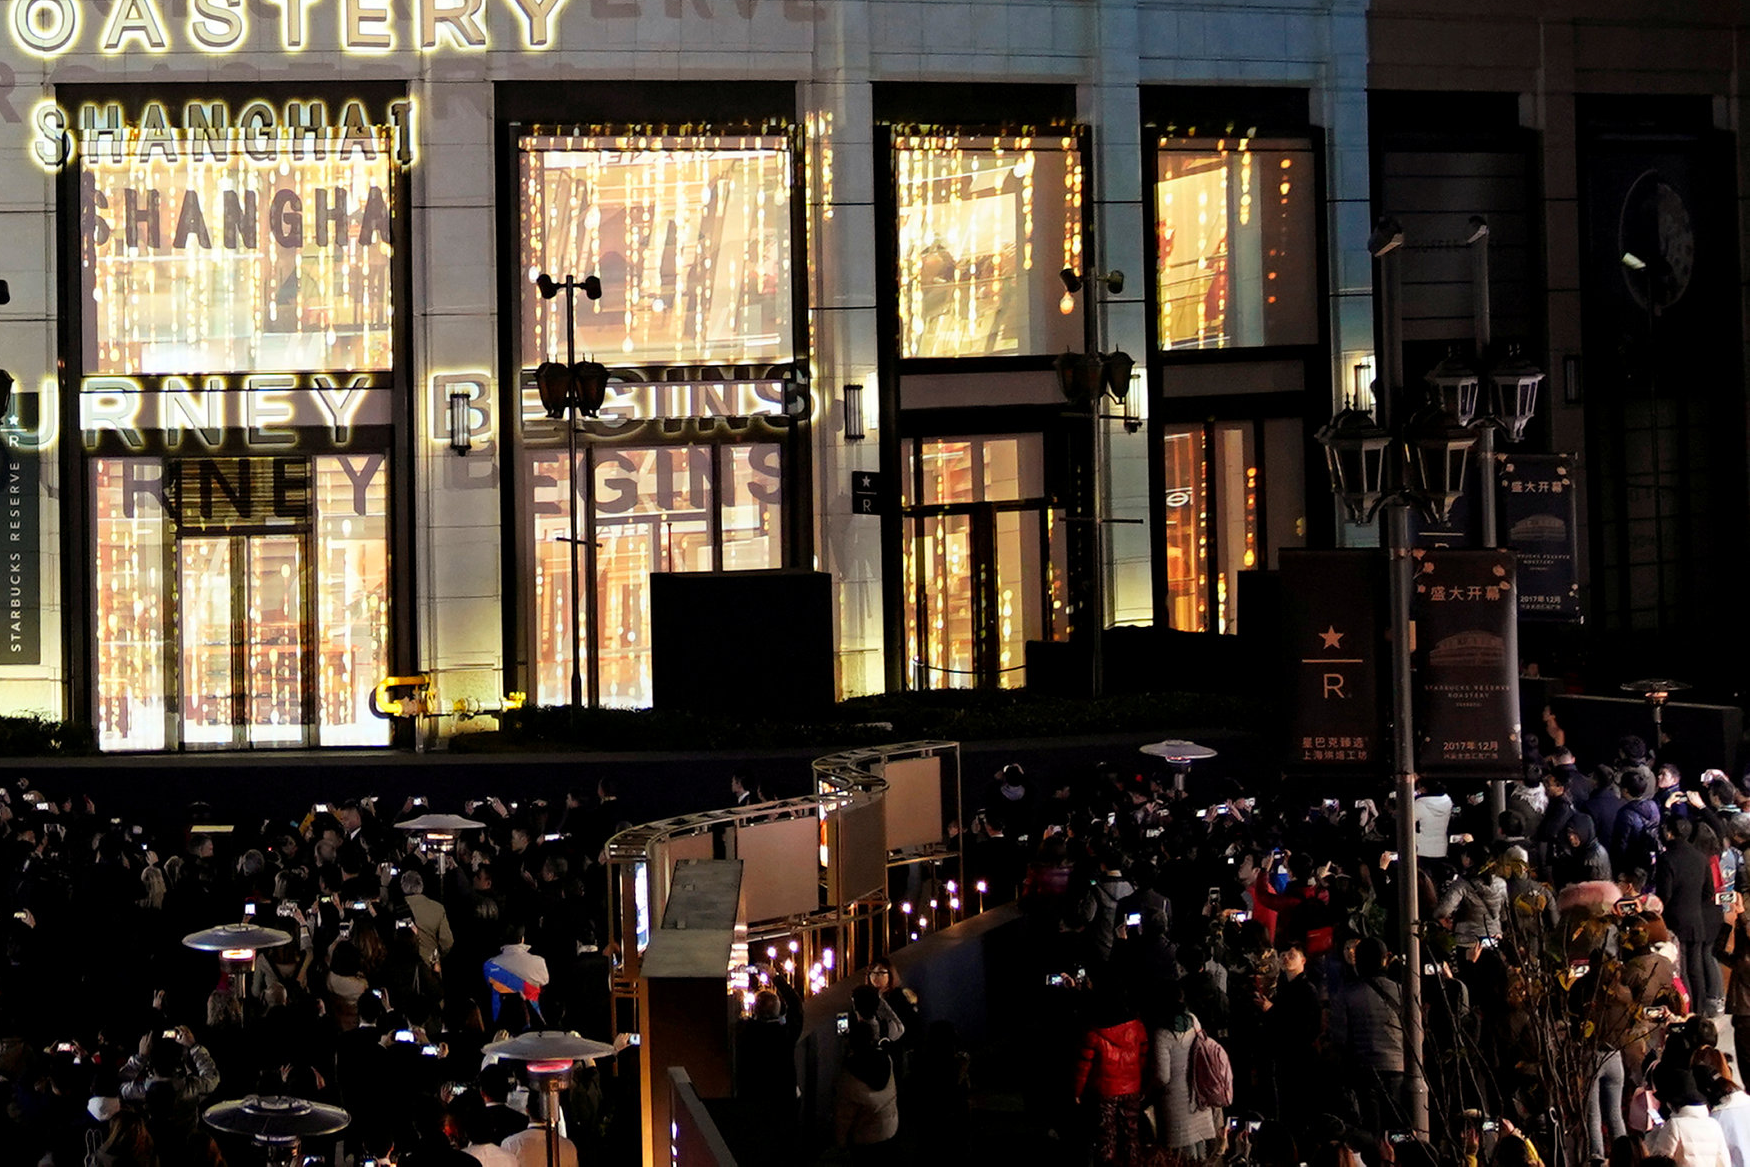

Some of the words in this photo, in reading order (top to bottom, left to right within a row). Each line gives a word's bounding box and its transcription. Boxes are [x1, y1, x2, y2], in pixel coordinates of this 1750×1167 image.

[35, 101, 413, 166] SHANGHAI
[9, 434, 19, 448] R
[1511, 480, 1563, 493] 盛大开幕
[9, 461, 21, 542] RESERVE
[862, 498, 872, 513] R
[1430, 585, 1501, 602] 盛大开幕
[10, 553, 22, 653] STARBUCKS
[1322, 672, 1345, 699] R
[1443, 740, 1475, 751] 2017年
[1477, 740, 1499, 751] 12月
